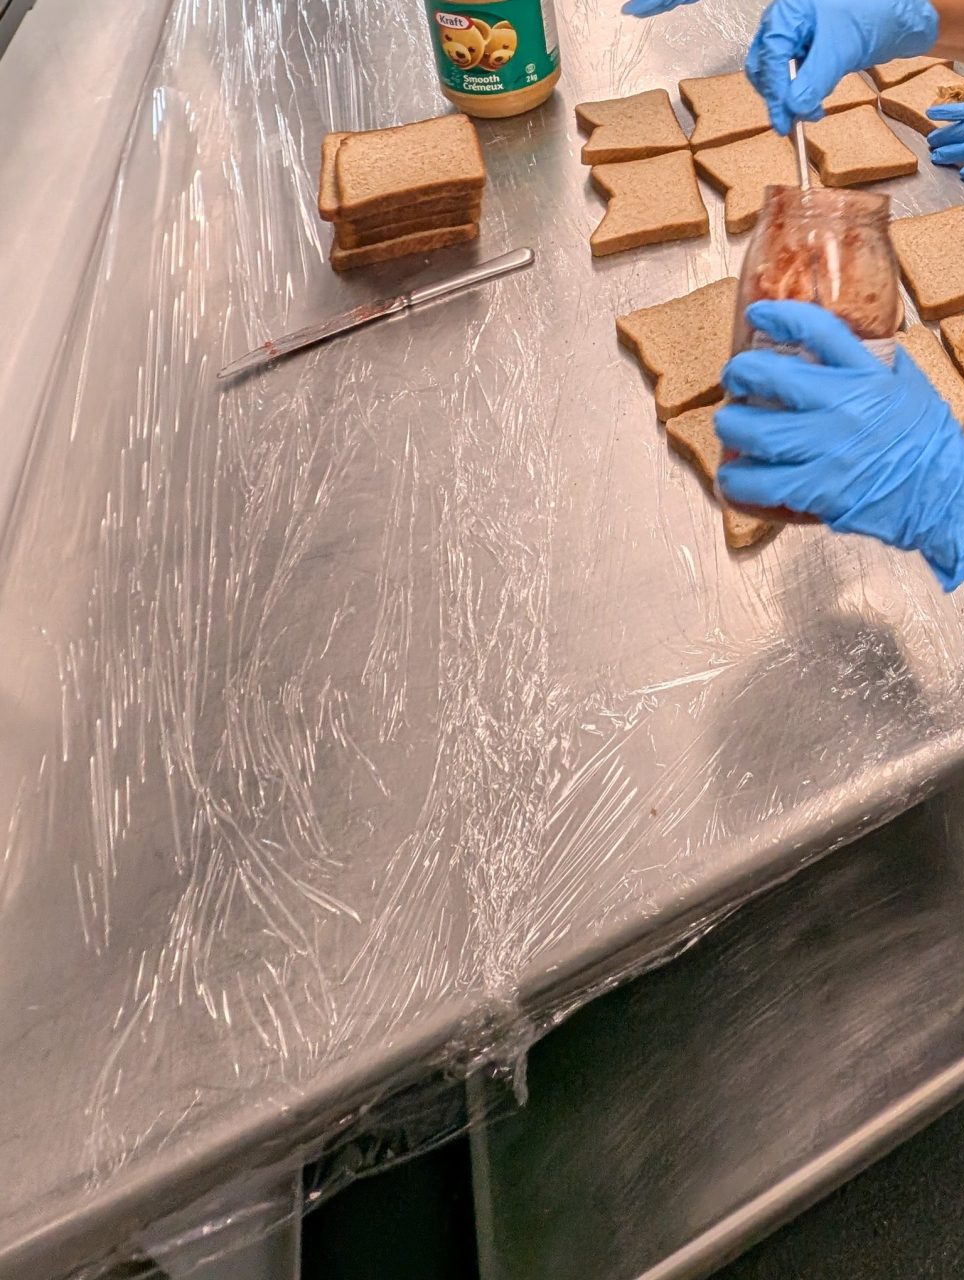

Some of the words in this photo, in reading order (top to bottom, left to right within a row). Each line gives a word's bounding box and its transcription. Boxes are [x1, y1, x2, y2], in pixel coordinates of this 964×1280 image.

[439, 14, 463, 27] Kraft
[463, 74, 500, 83] Smooth
[463, 81, 504, 91] Crémeux
